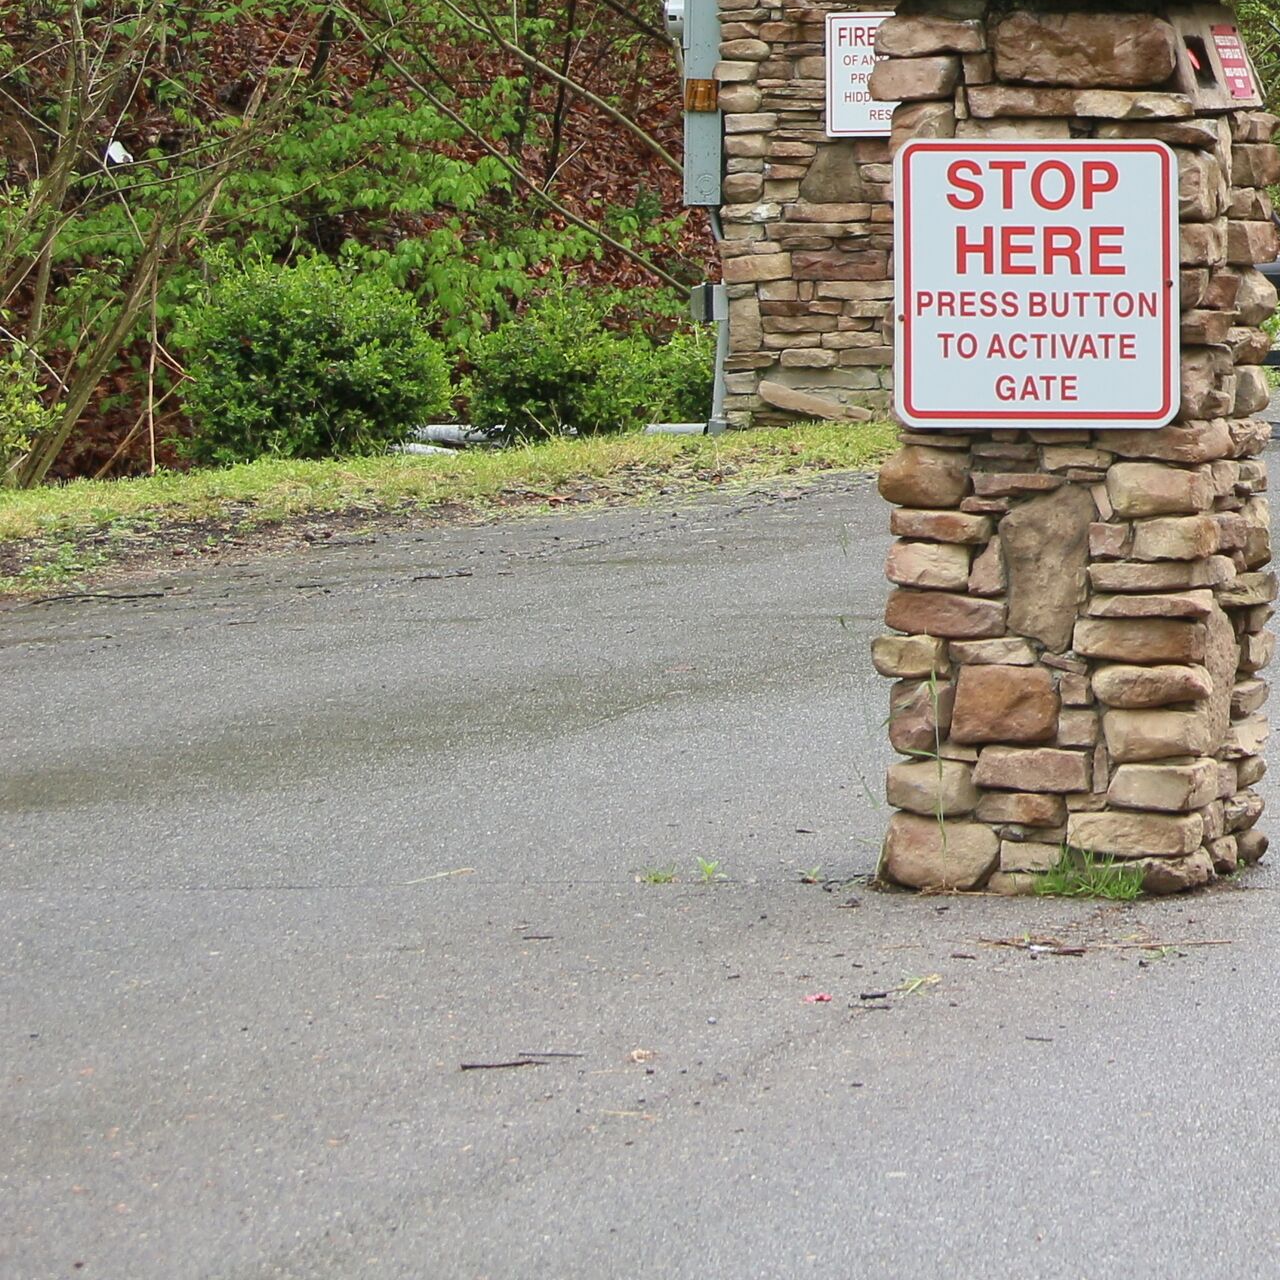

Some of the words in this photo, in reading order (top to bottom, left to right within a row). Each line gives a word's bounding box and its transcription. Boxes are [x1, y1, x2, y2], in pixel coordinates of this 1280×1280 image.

[838, 26, 876, 47] FIRE
[843, 55, 859, 66] OF
[844, 91, 872, 103] HIDD
[869, 109, 892, 121] RES
[945, 159, 1120, 211] STOP
[955, 226, 1126, 276] HERE
[916, 290, 1019, 318] PRESS
[1028, 291, 1158, 318] BUTTON
[937, 333, 978, 360] TO
[986, 333, 1137, 360] ACTIVATE
[995, 374, 1079, 401] GATE
